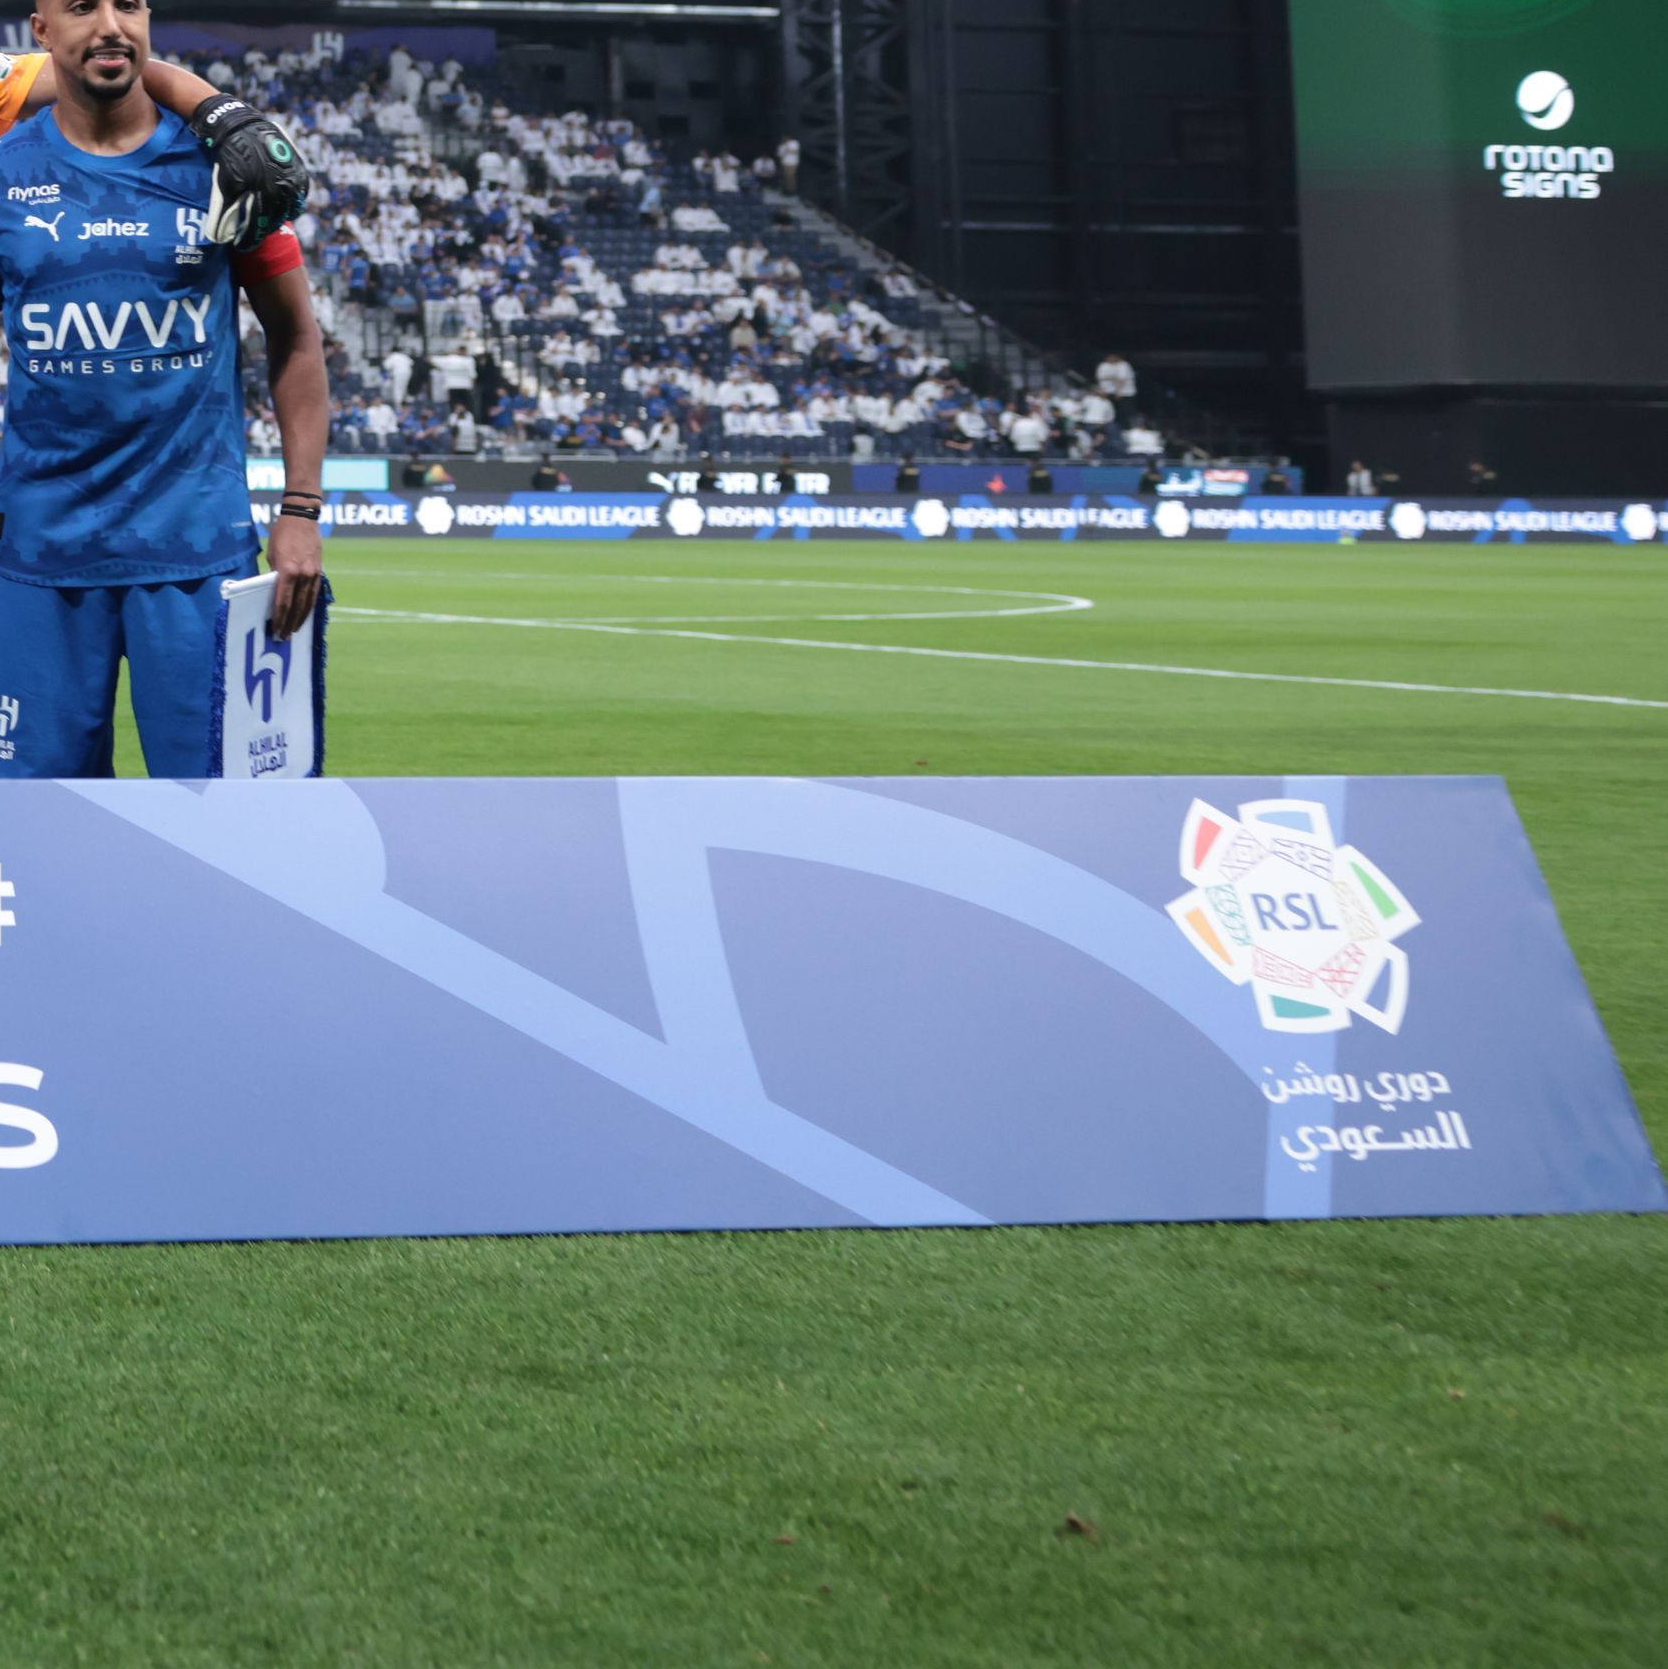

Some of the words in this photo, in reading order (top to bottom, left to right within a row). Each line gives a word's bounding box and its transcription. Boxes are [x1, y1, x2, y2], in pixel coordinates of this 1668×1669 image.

[207, 100, 246, 122] BONO
[8, 184, 60, 200] flynas
[21, 294, 212, 351] SAVVY
[29, 359, 115, 374] GAMES
[333, 504, 408, 525] LEAGUE
[456, 504, 528, 525] ROSHN
[528, 504, 586, 526] SAUDI
[587, 504, 661, 527] LEAGUE
[706, 506, 776, 527] ROSHN
[777, 506, 833, 528] SAUDI
[834, 506, 908, 528] LEAGUE
[951, 507, 1019, 528] ROSHN
[1019, 507, 1077, 528] SAUDI
[1079, 507, 1149, 528] LEAGUE
[1192, 509, 1259, 529] ROSHN
[1260, 509, 1312, 530] SAUDI
[1314, 509, 1386, 531] LEAGUE
[1426, 511, 1493, 531] ROSHN
[1494, 511, 1548, 532] SAUDI
[1549, 511, 1618, 532] LEAGUE
[1250, 893, 1341, 932] RSL
[1260, 1061, 1362, 1104] روشن
[1364, 1070, 1452, 1112] دوري
[1280, 1111, 1473, 1173] السعودي
